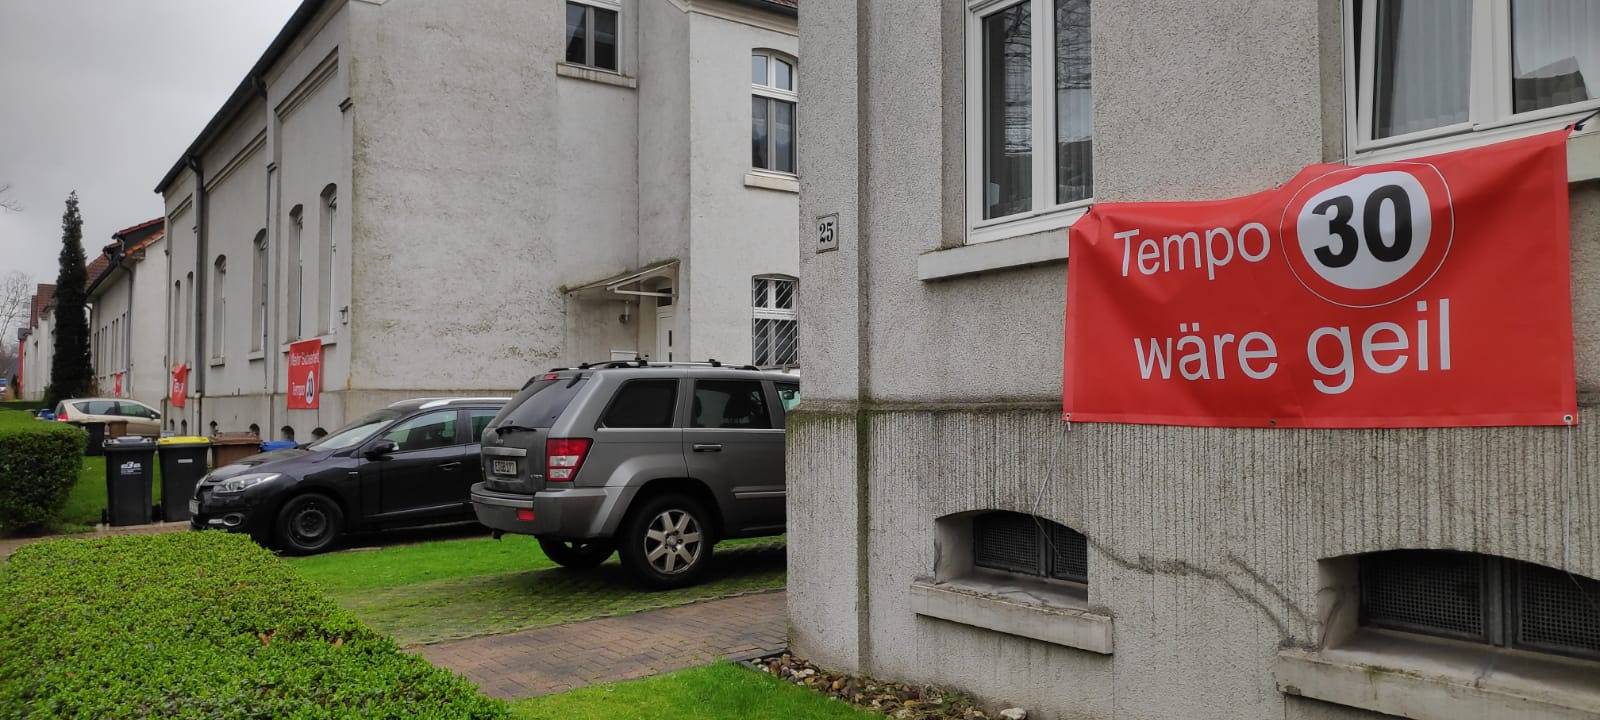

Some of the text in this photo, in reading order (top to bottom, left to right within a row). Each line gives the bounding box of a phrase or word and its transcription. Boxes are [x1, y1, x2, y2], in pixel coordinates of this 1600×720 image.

[819, 221, 834, 243] 25
[1113, 184, 1414, 281] Tempo 30
[1133, 298, 1451, 395] wäre geil
